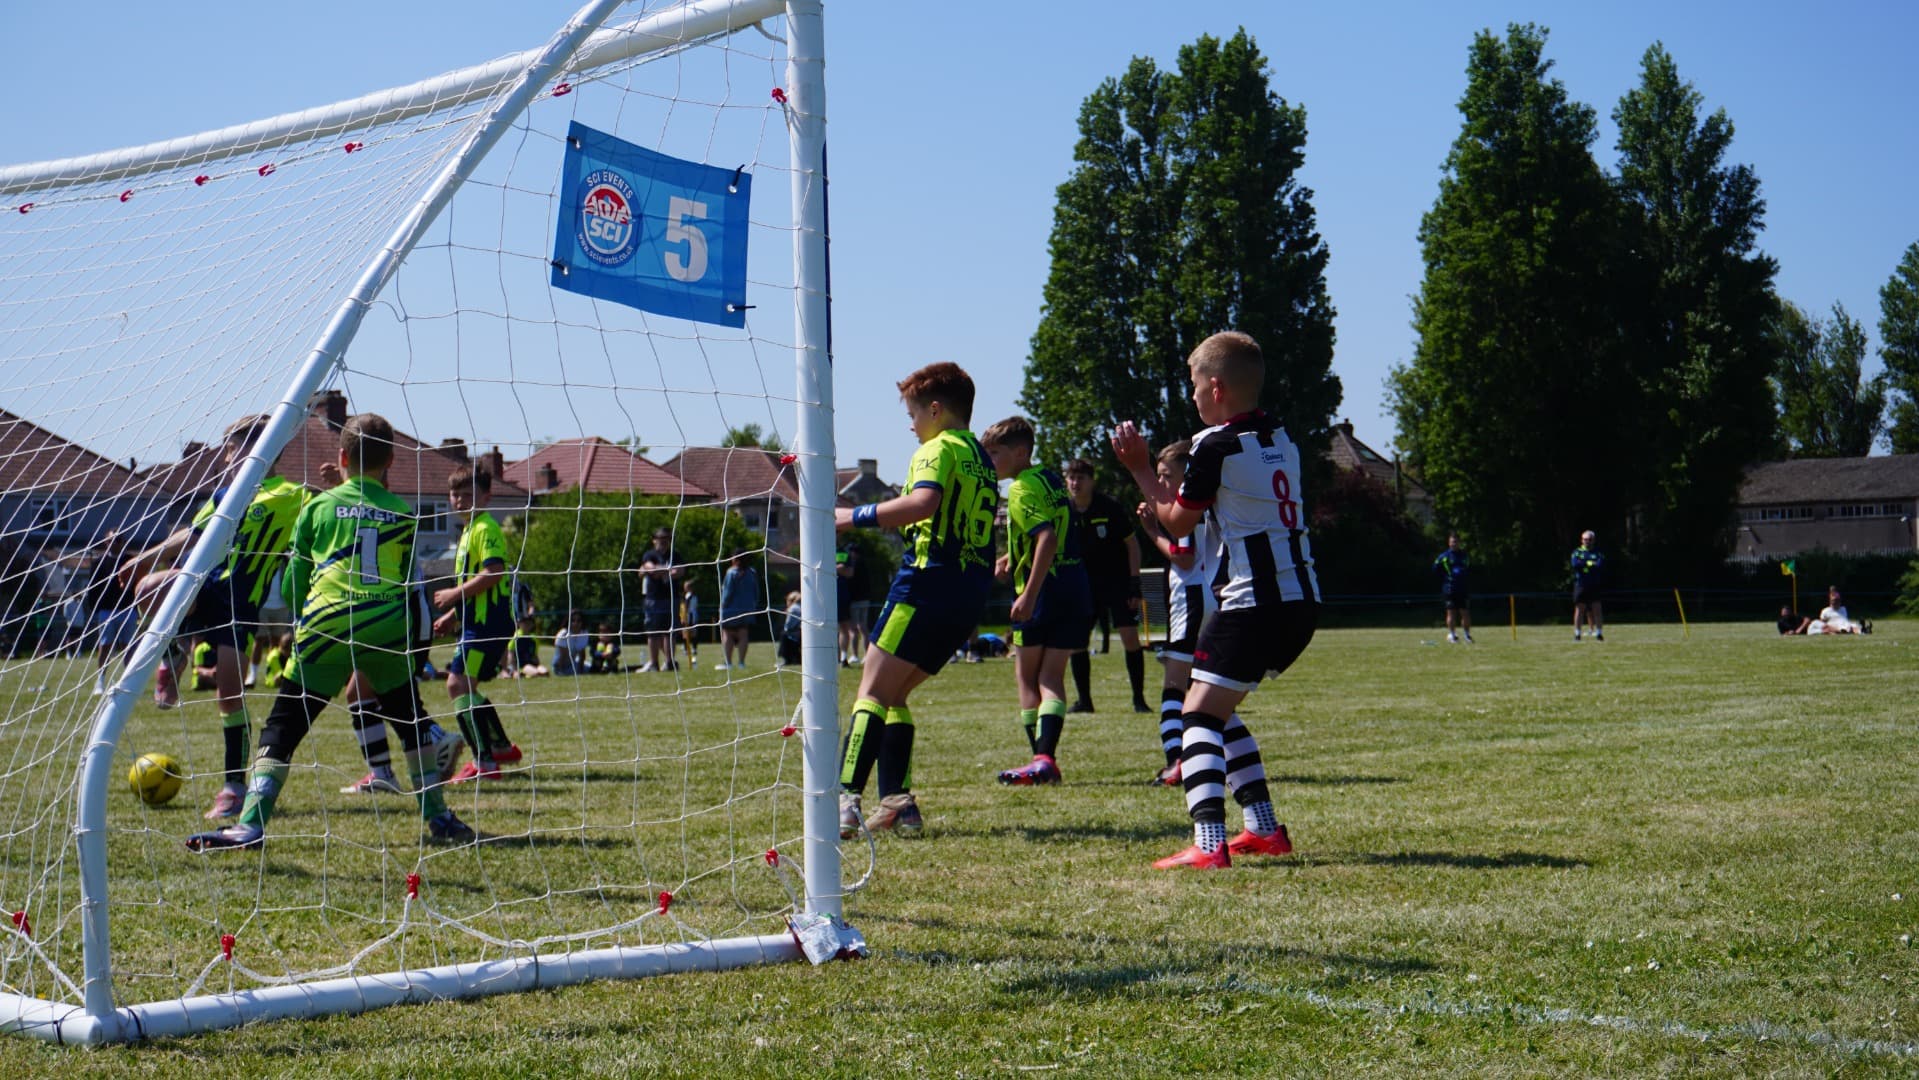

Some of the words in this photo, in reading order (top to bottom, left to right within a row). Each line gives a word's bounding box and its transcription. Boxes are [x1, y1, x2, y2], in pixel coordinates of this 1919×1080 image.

[587, 173, 600, 187] SCI
[603, 171, 633, 199] EVENTS
[590, 218, 622, 243] SCI
[665, 196, 708, 282] 5
[336, 505, 397, 523] BAKER
[1272, 469, 1297, 529] 8
[355, 527, 381, 585] 1
